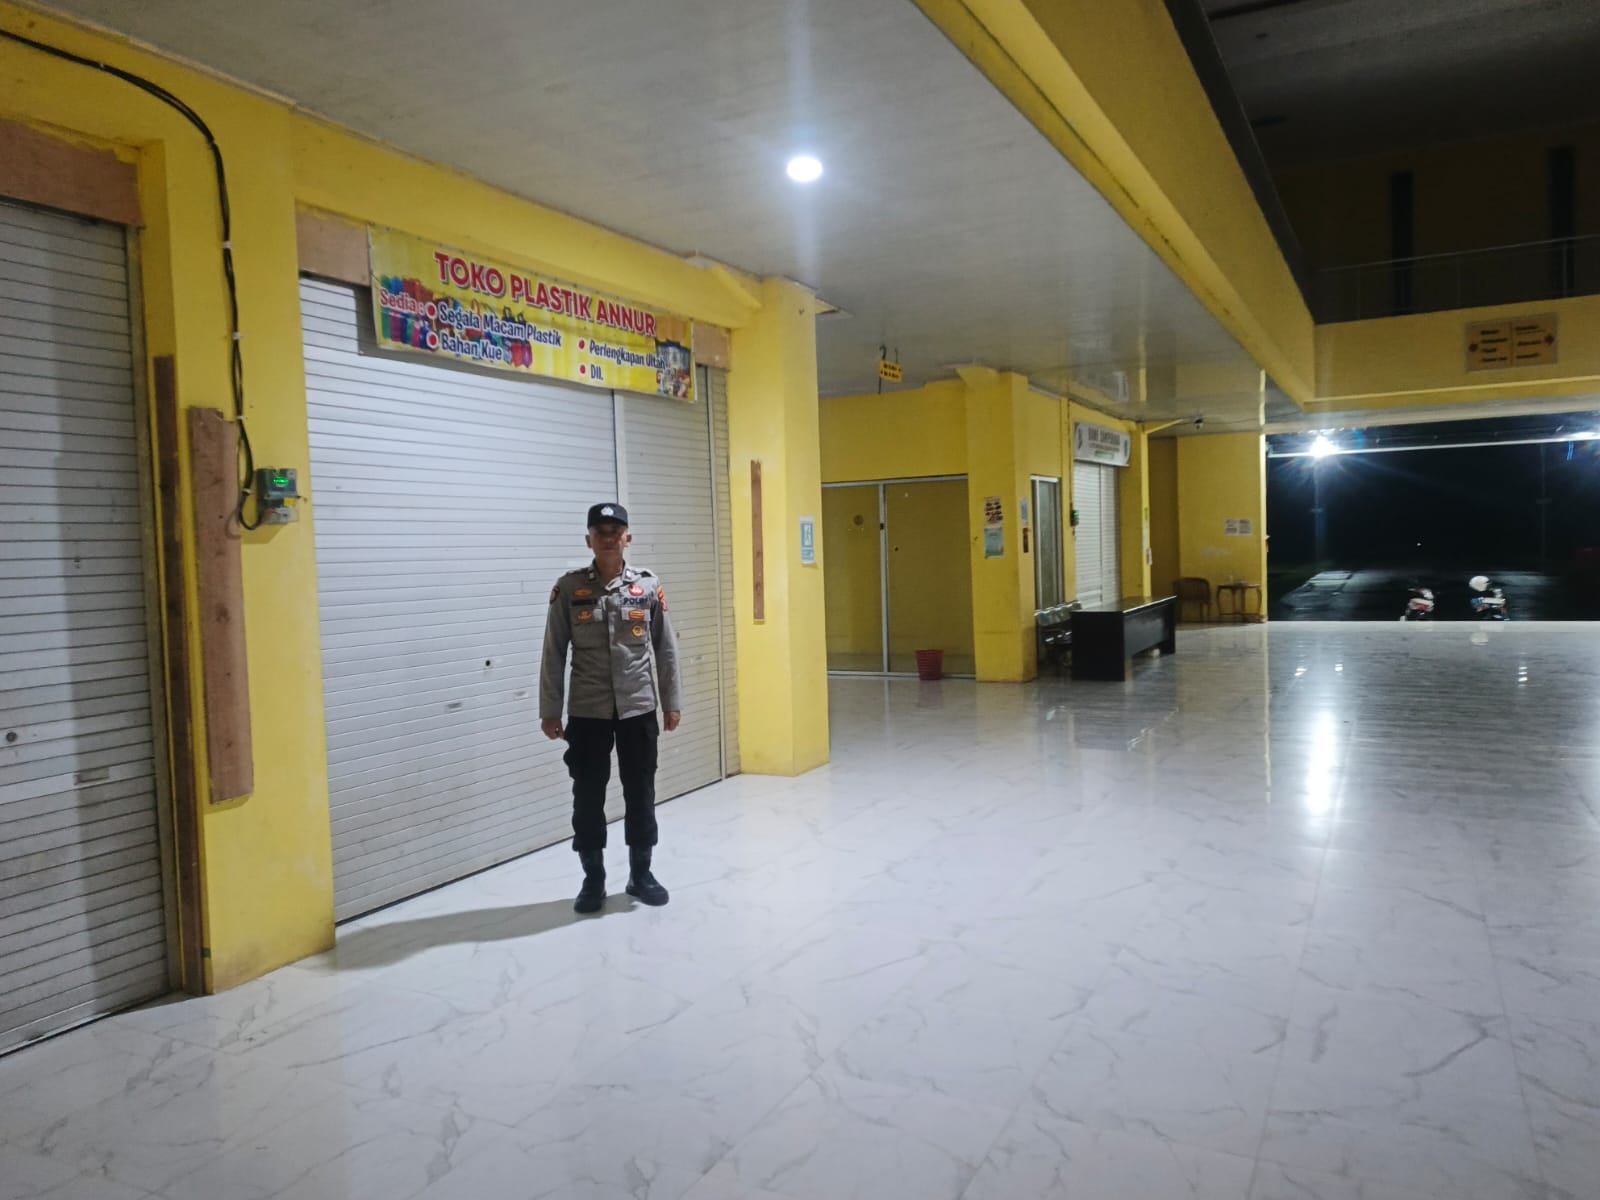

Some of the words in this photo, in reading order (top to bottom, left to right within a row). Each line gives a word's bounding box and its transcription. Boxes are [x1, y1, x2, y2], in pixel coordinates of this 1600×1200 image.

[434, 251, 506, 296] TOKO
[510, 273, 593, 320] PLASTIK
[596, 300, 656, 336] ANNUR
[439, 301, 480, 330] Segala
[484, 314, 525, 340] Macam
[527, 324, 562, 347] Plastik
[441, 333, 479, 359] Bahan
[481, 342, 503, 362] Kue
[589, 339, 645, 365] Perlengkapan
[646, 353, 667, 370] Ultah
